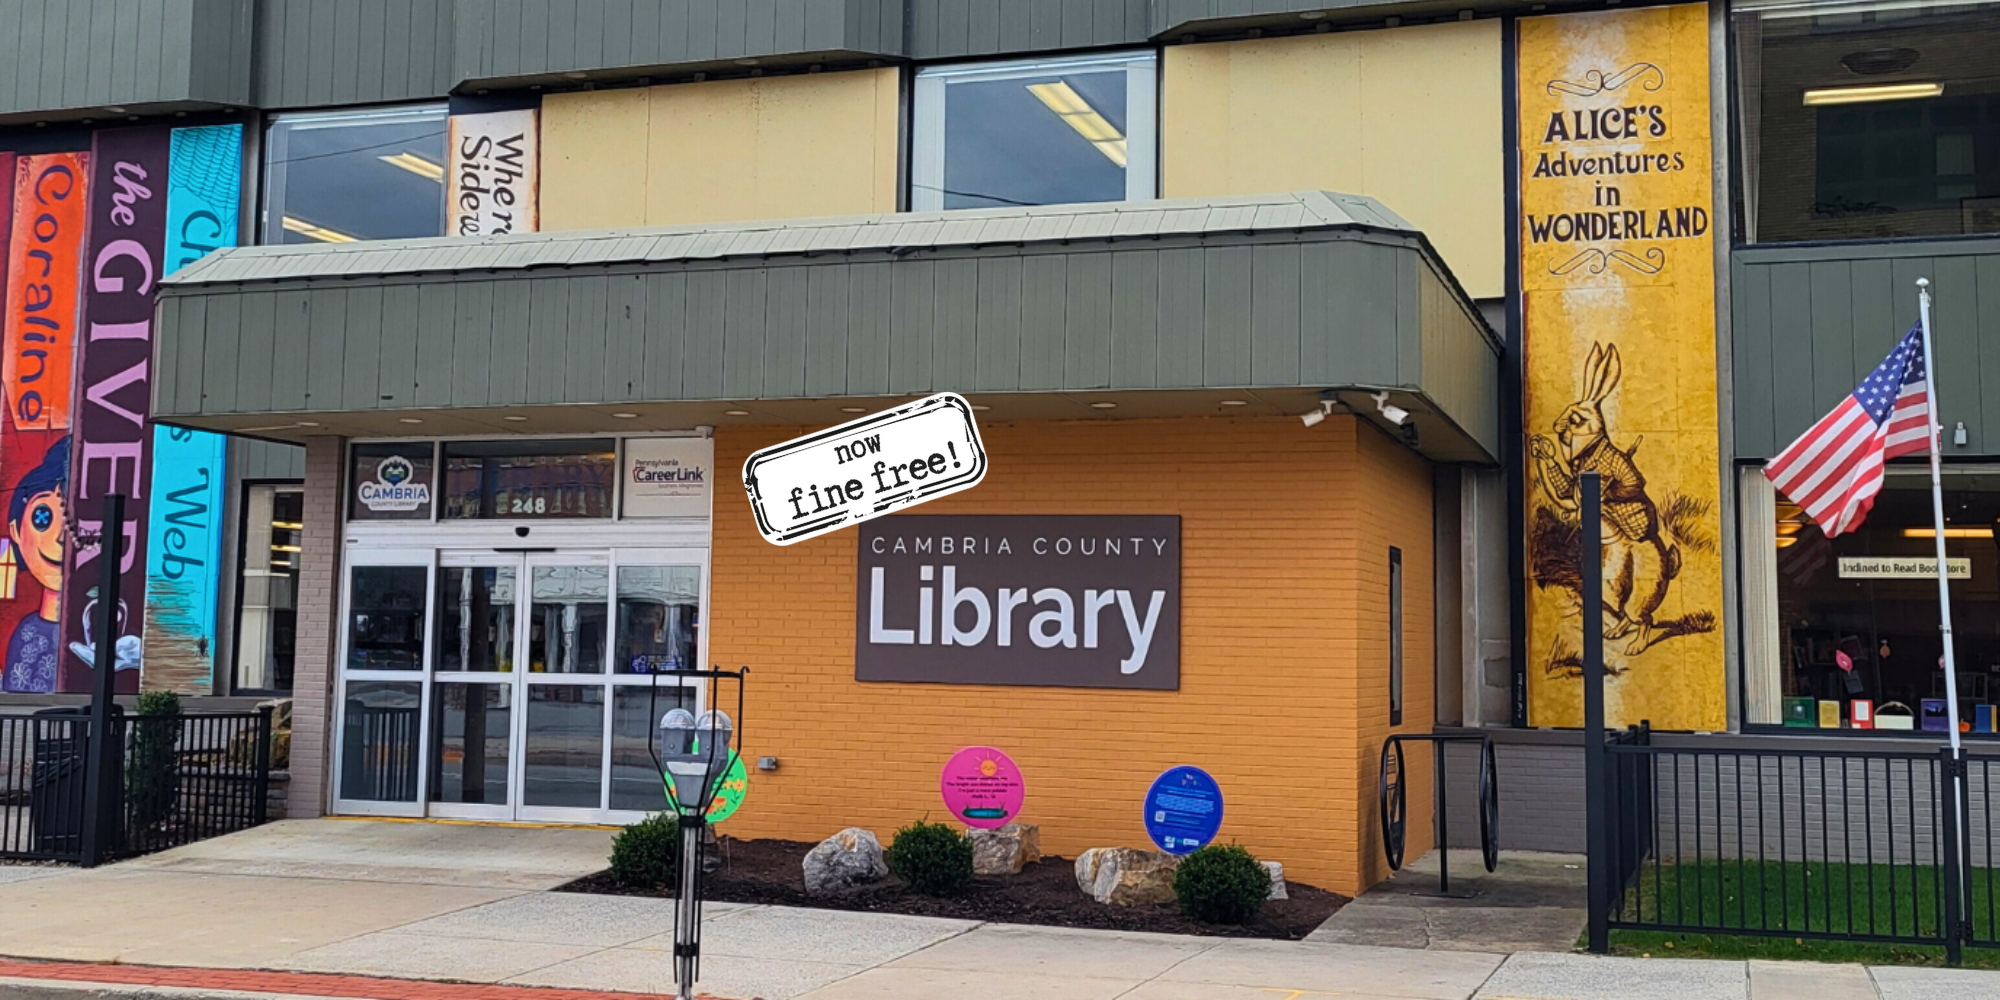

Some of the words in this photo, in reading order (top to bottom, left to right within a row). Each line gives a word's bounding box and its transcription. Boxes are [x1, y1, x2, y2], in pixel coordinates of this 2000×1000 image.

[1544, 105, 1667, 143] ALICE'S
[1532, 151, 1685, 178] Adventures
[110, 160, 152, 227] the
[1595, 180, 1621, 206] in
[1527, 206, 1708, 243] WONDERLAND
[18, 164, 74, 422] Coraline
[635, 458, 679, 468] Pennsylvania
[636, 466, 704, 481] CareerLink
[361, 485, 427, 499] CAMBRIA
[511, 497, 546, 514] 248
[162, 467, 209, 580] Web
[871, 537, 1012, 554] CAMBRIA
[1033, 537, 1167, 555] COUNTY
[1881, 564, 1891, 574] to
[1893, 563, 1916, 574] Read
[1919, 563, 1967, 574] Bootore
[869, 565, 1167, 675] Library
